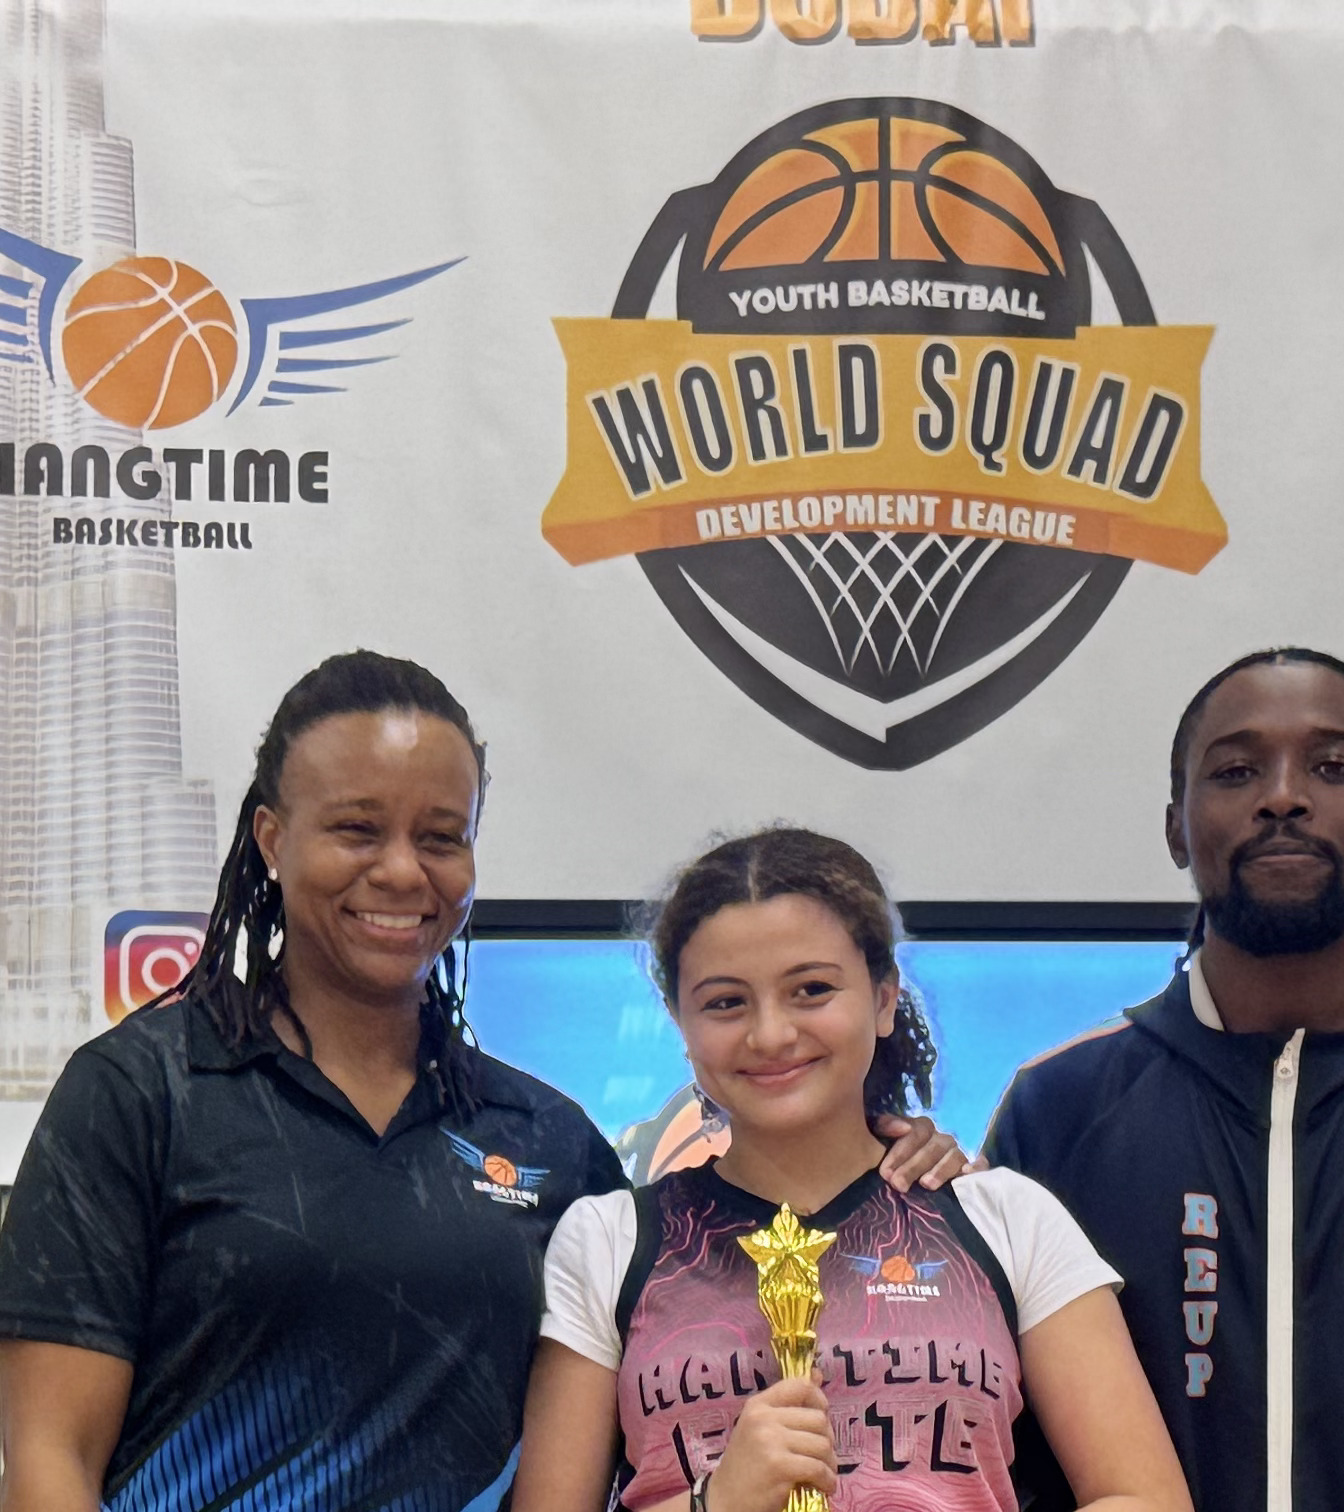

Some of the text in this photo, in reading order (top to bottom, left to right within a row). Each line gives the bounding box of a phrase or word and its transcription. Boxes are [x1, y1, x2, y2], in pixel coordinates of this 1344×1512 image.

[729, 279, 1046, 321] YOUTH BASKETBALL
[589, 342, 1185, 501] WORLD SQUAD
[53, 516, 253, 550] BASKETBALL
[695, 495, 1077, 545] DEVELOPMENT LEAGUE
[1181, 1192, 1219, 1398] REUP
[633, 1338, 1004, 1417] HANTIME
[670, 1396, 982, 1487] EITE
